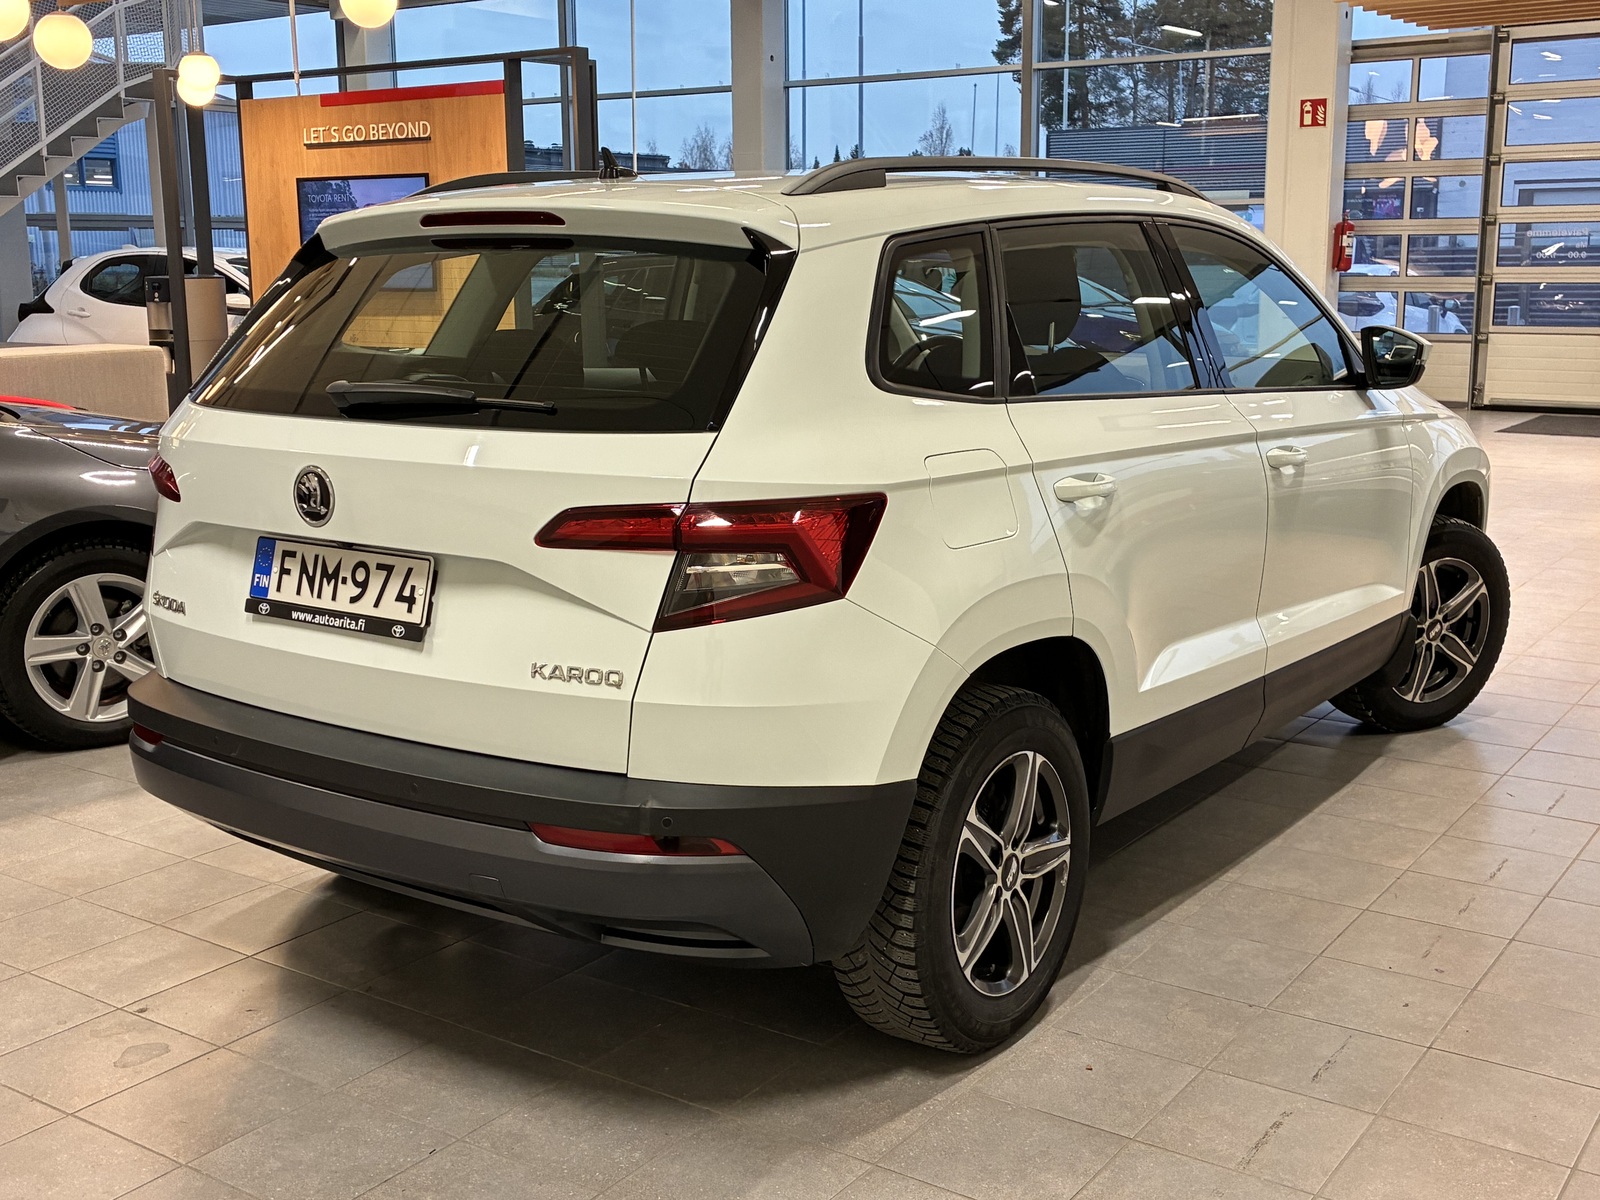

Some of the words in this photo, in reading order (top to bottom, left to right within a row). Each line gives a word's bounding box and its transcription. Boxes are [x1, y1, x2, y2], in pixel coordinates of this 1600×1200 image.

[342, 125, 366, 142] GO
[369, 121, 431, 140] BEYOND
[307, 193, 332, 203] TOYOTA
[333, 193, 350, 203] RENT
[253, 573, 270, 588] FIN
[275, 549, 417, 614] FNM-974
[291, 610, 366, 632] www.autoarita.fi
[530, 661, 624, 690] KAROQ
